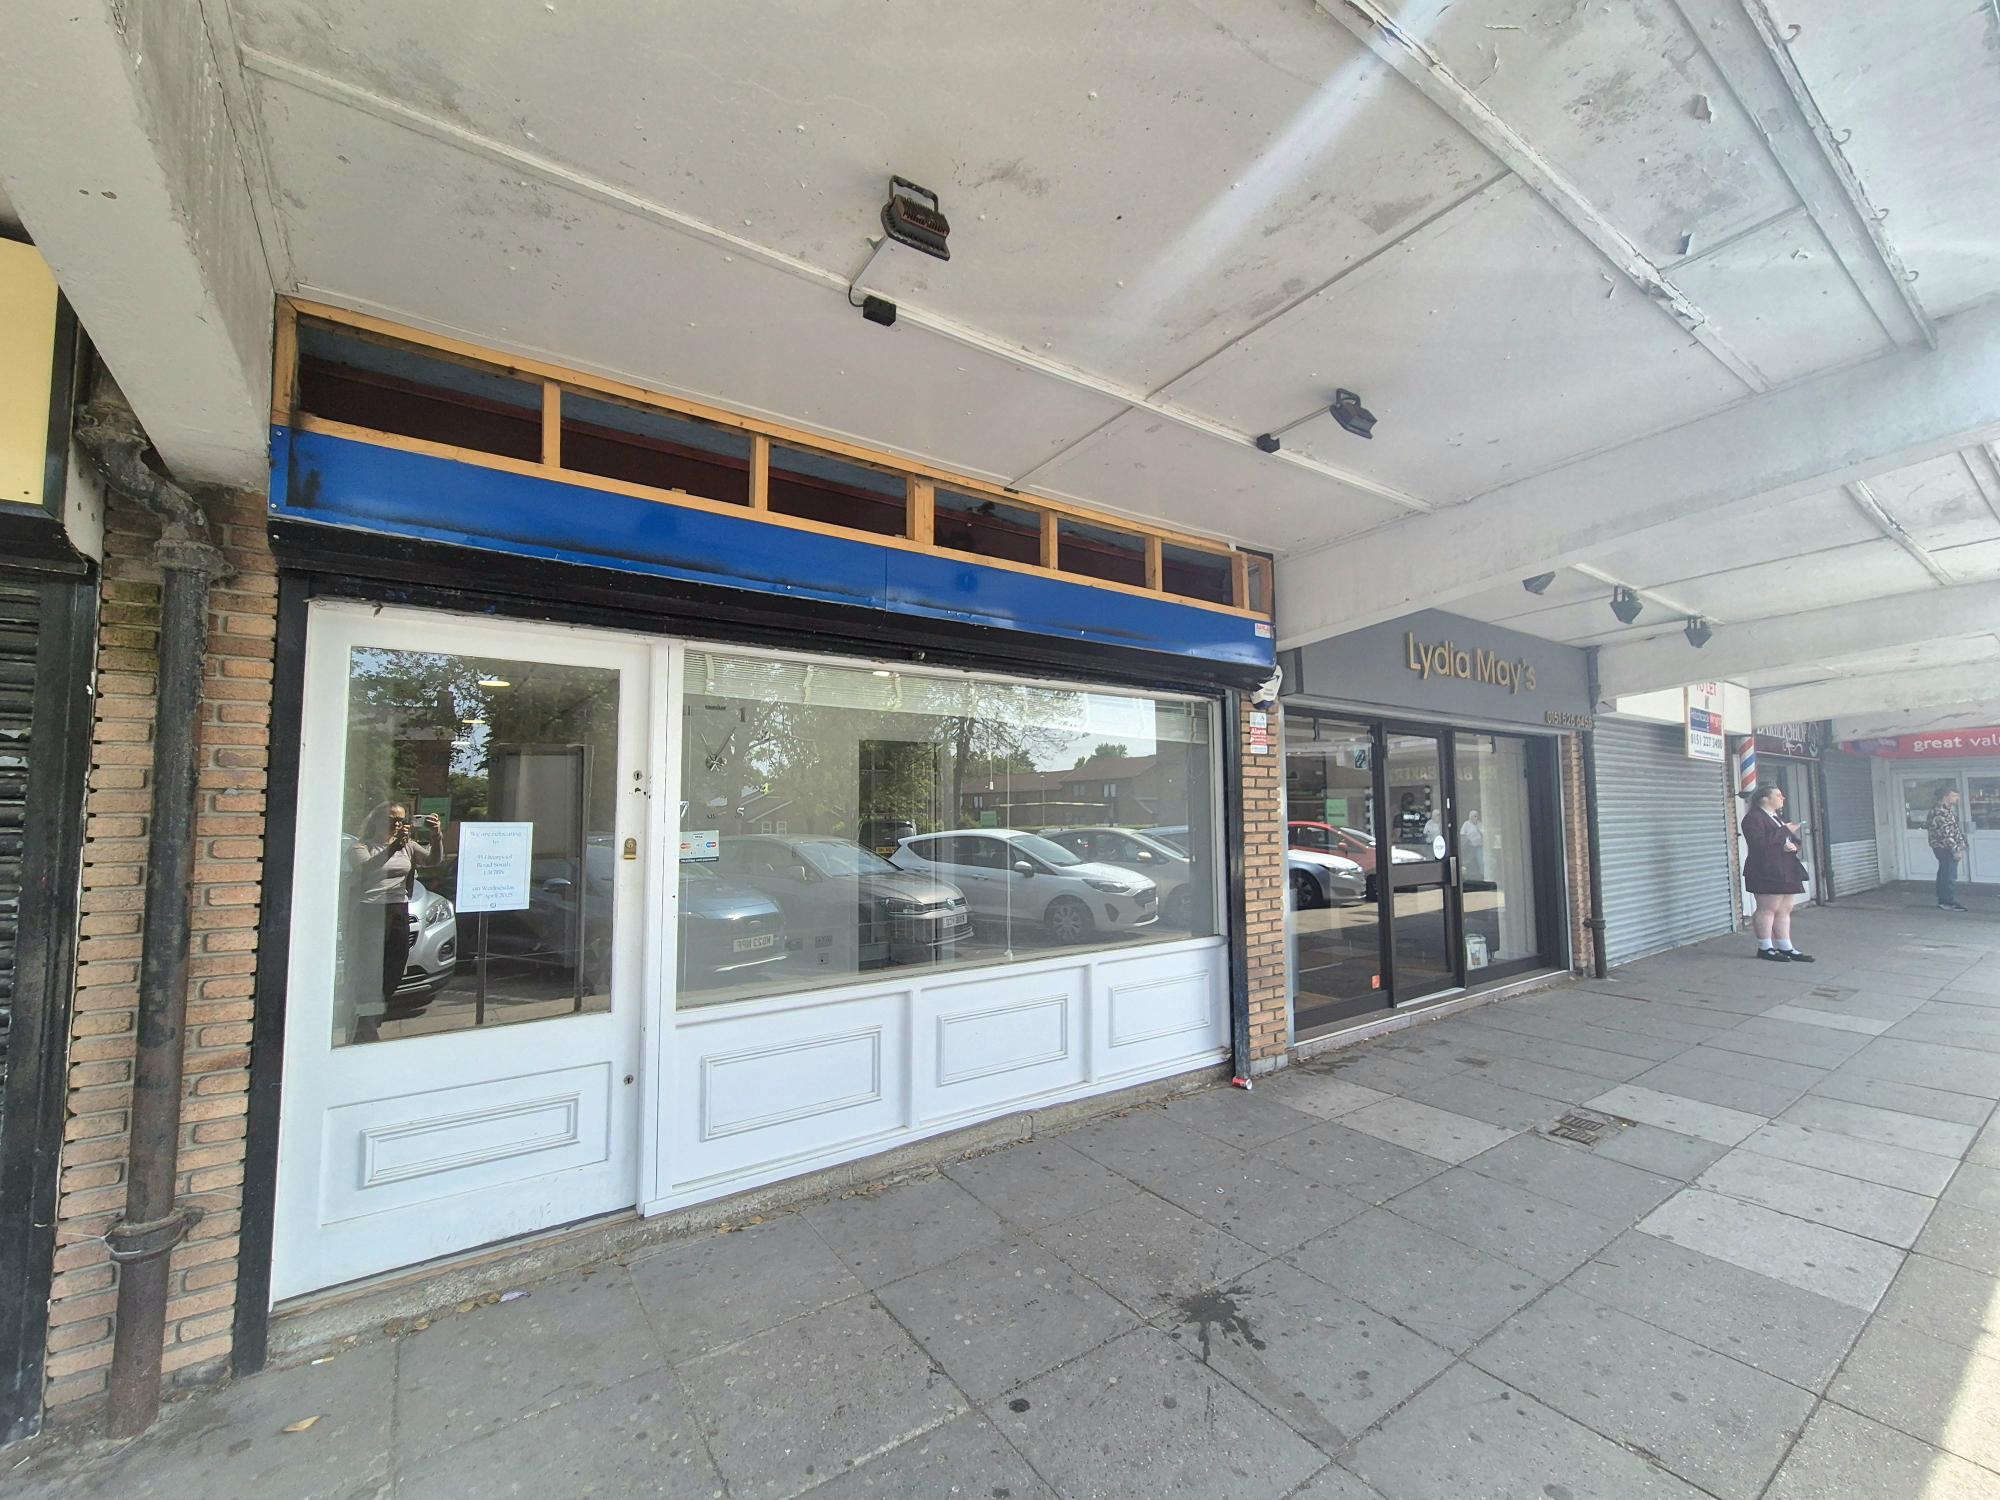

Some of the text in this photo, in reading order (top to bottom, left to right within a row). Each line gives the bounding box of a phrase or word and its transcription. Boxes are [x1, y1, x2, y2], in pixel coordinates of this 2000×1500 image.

[1405, 631, 1537, 695] Lydia May's
[1705, 682, 1717, 696] LET
[1546, 711, 1560, 725] 0151
[1561, 712, 1576, 727] 526
[1691, 733, 1702, 745] 0151
[1703, 736, 1712, 747] 227
[1913, 737, 1962, 752] great
[1970, 734, 2000, 746] val
